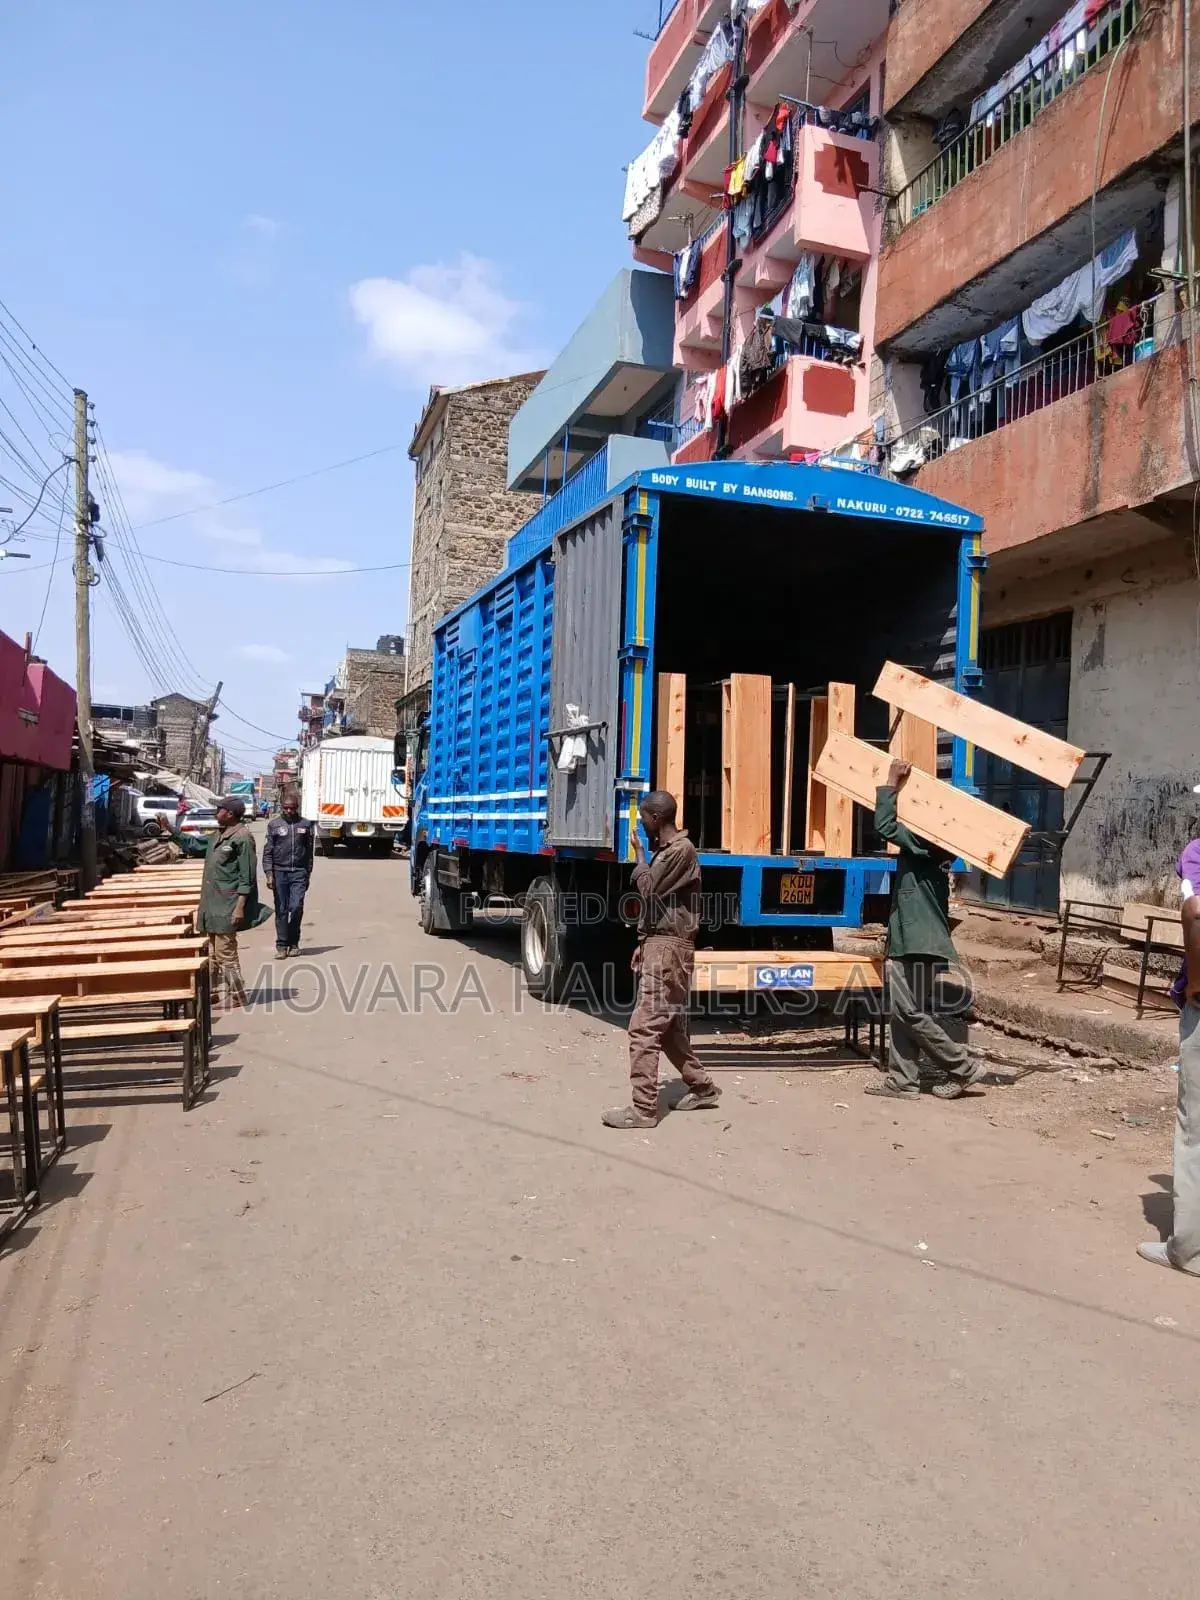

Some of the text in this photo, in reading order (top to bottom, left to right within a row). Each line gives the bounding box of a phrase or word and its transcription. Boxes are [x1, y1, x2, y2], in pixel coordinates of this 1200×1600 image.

[651, 472, 679, 487] BODY
[686, 477, 717, 492] BUILT
[723, 482, 738, 495] BY
[836, 497, 887, 514] NAKURU
[780, 969, 811, 978] PLAN
